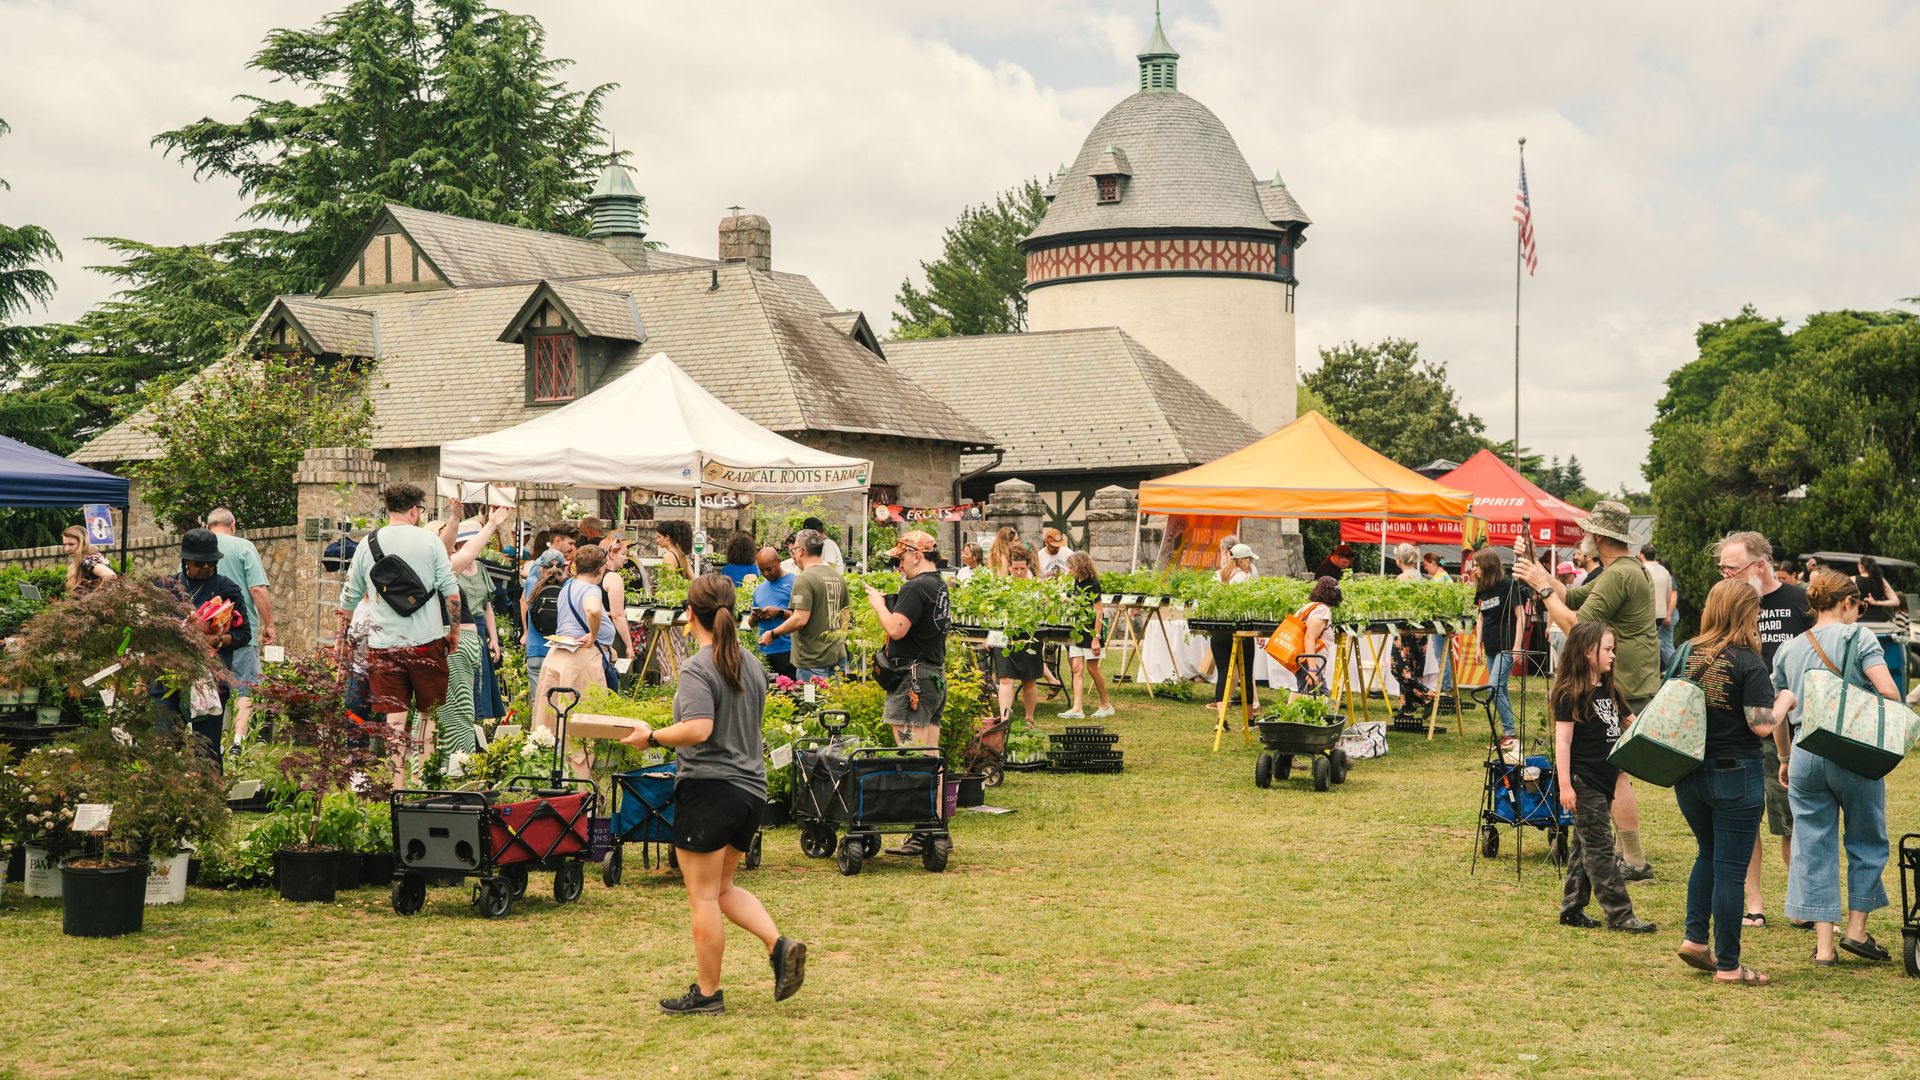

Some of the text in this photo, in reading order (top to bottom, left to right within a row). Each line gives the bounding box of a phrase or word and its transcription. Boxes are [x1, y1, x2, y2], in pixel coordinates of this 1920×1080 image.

[722, 469, 777, 484] RADICAL
[780, 469, 822, 484] ROOTS
[825, 469, 858, 483] FARM
[1473, 497, 1526, 506] SPIRITS
[906, 508, 952, 520] FRUTS
[1417, 522, 1429, 532] VA
[1760, 608, 1792, 619] WATER
[1758, 620, 1782, 631] HARD
[1761, 633, 1794, 643] RACISM
